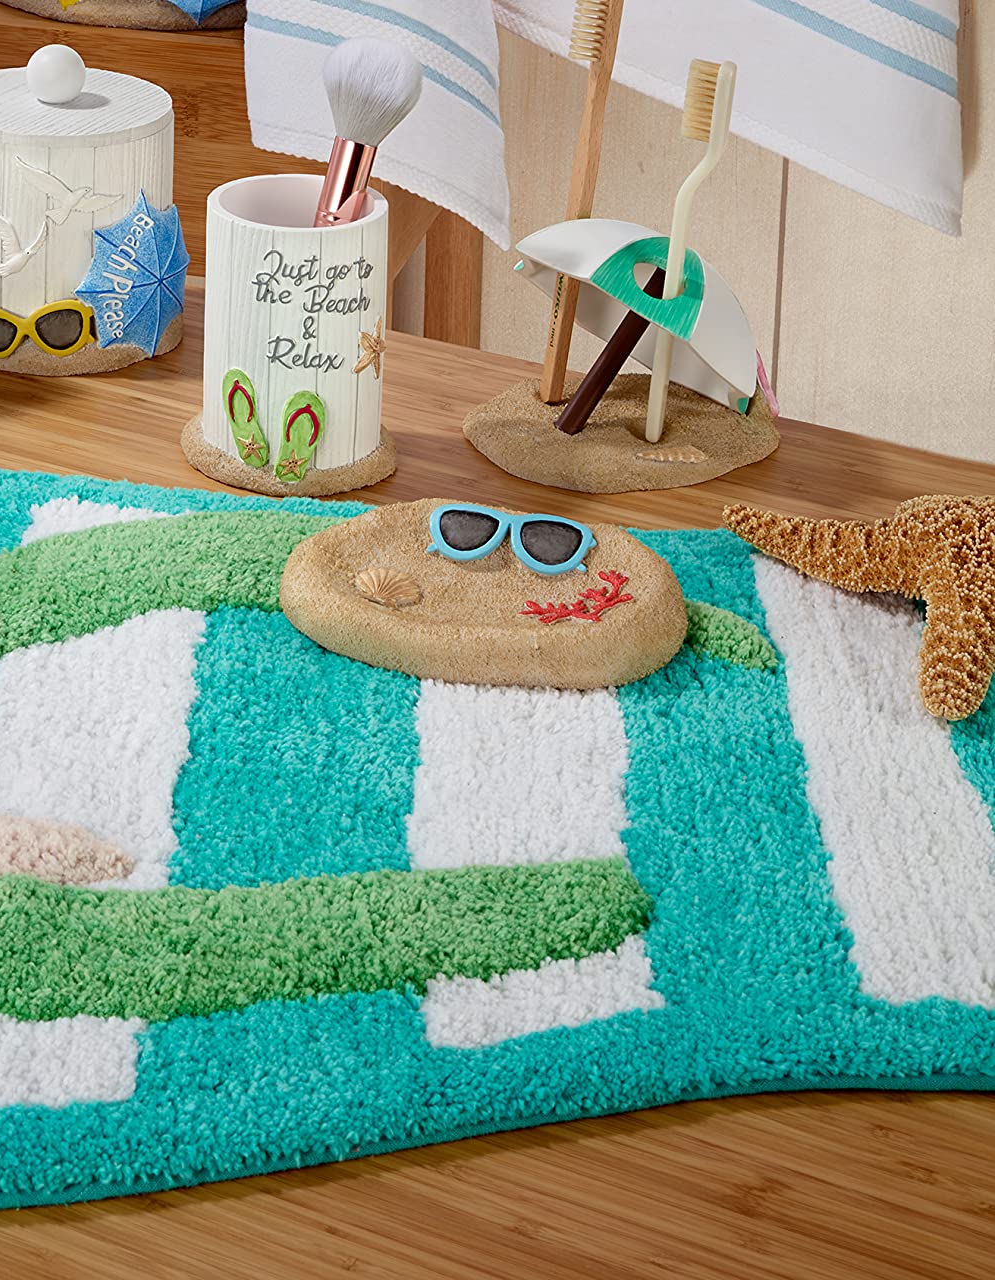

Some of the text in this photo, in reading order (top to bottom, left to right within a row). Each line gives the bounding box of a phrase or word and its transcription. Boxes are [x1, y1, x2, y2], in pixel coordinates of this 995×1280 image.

[97, 213, 155, 339] Beach Please
[255, 249, 374, 291] Just go to
[252, 279, 371, 316] the Beach
[302, 316, 317, 341] &
[266, 336, 345, 373] Relax
